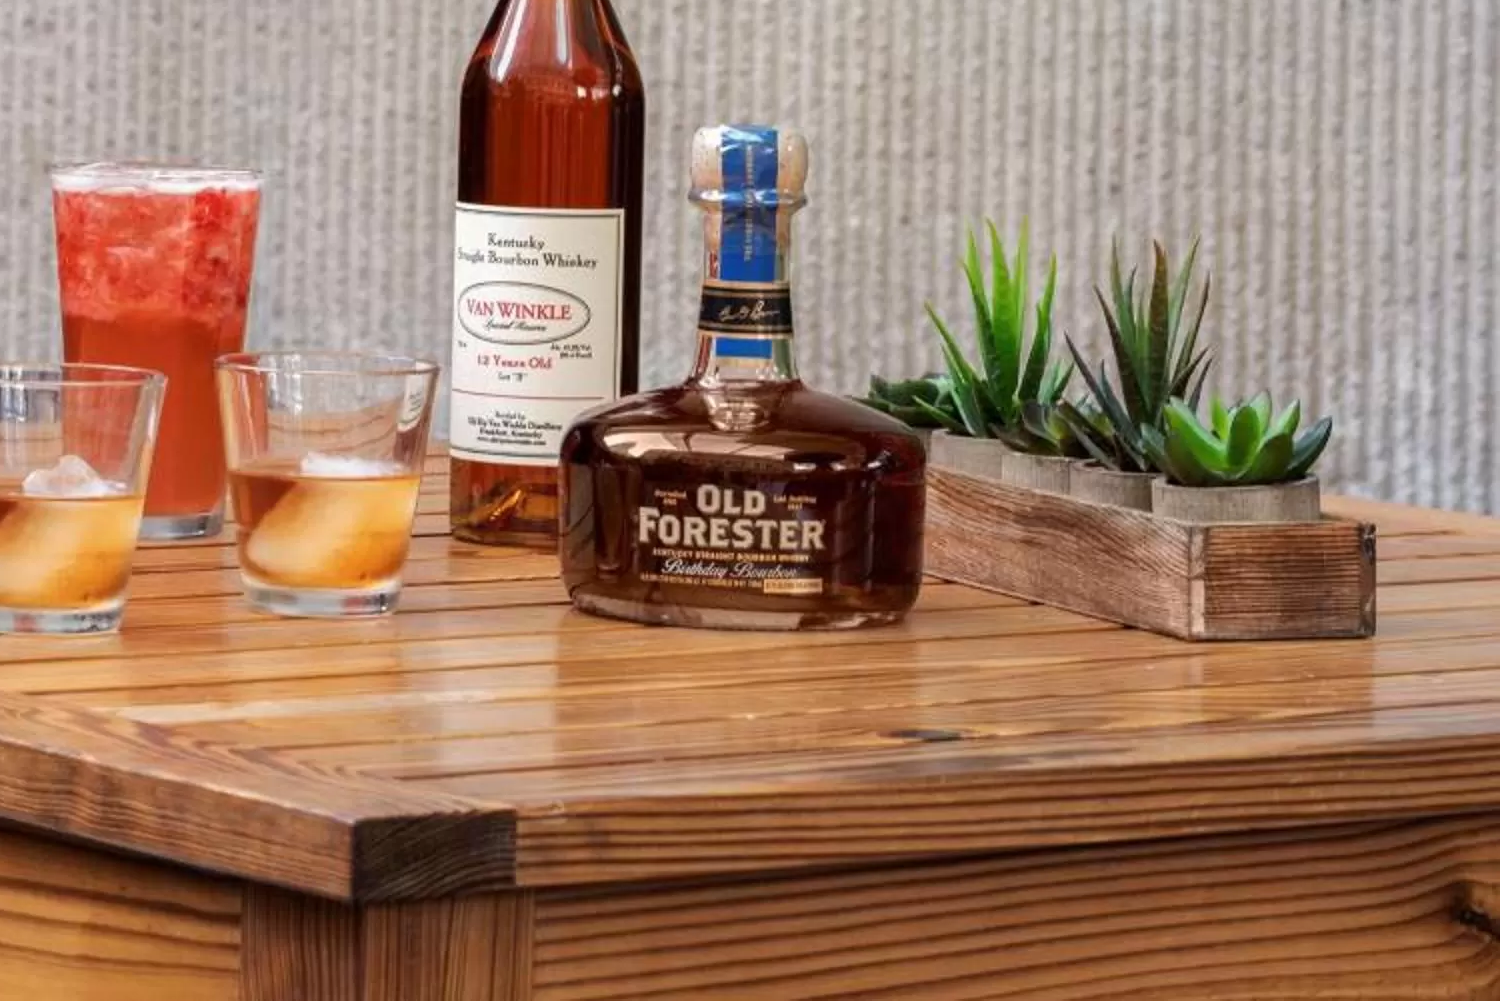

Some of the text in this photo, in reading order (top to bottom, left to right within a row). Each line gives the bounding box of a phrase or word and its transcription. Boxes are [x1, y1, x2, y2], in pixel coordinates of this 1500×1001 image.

[487, 233, 545, 250] Kentucky
[487, 251, 539, 267] Bourbon
[543, 253, 597, 269] Whiskey
[466, 298, 572, 320] VAN WINKLE
[477, 354, 553, 369] 12 Years Old
[697, 483, 766, 515] OLD
[638, 506, 826, 550] FORESTER
[662, 559, 798, 579] Birthday Bourbon
